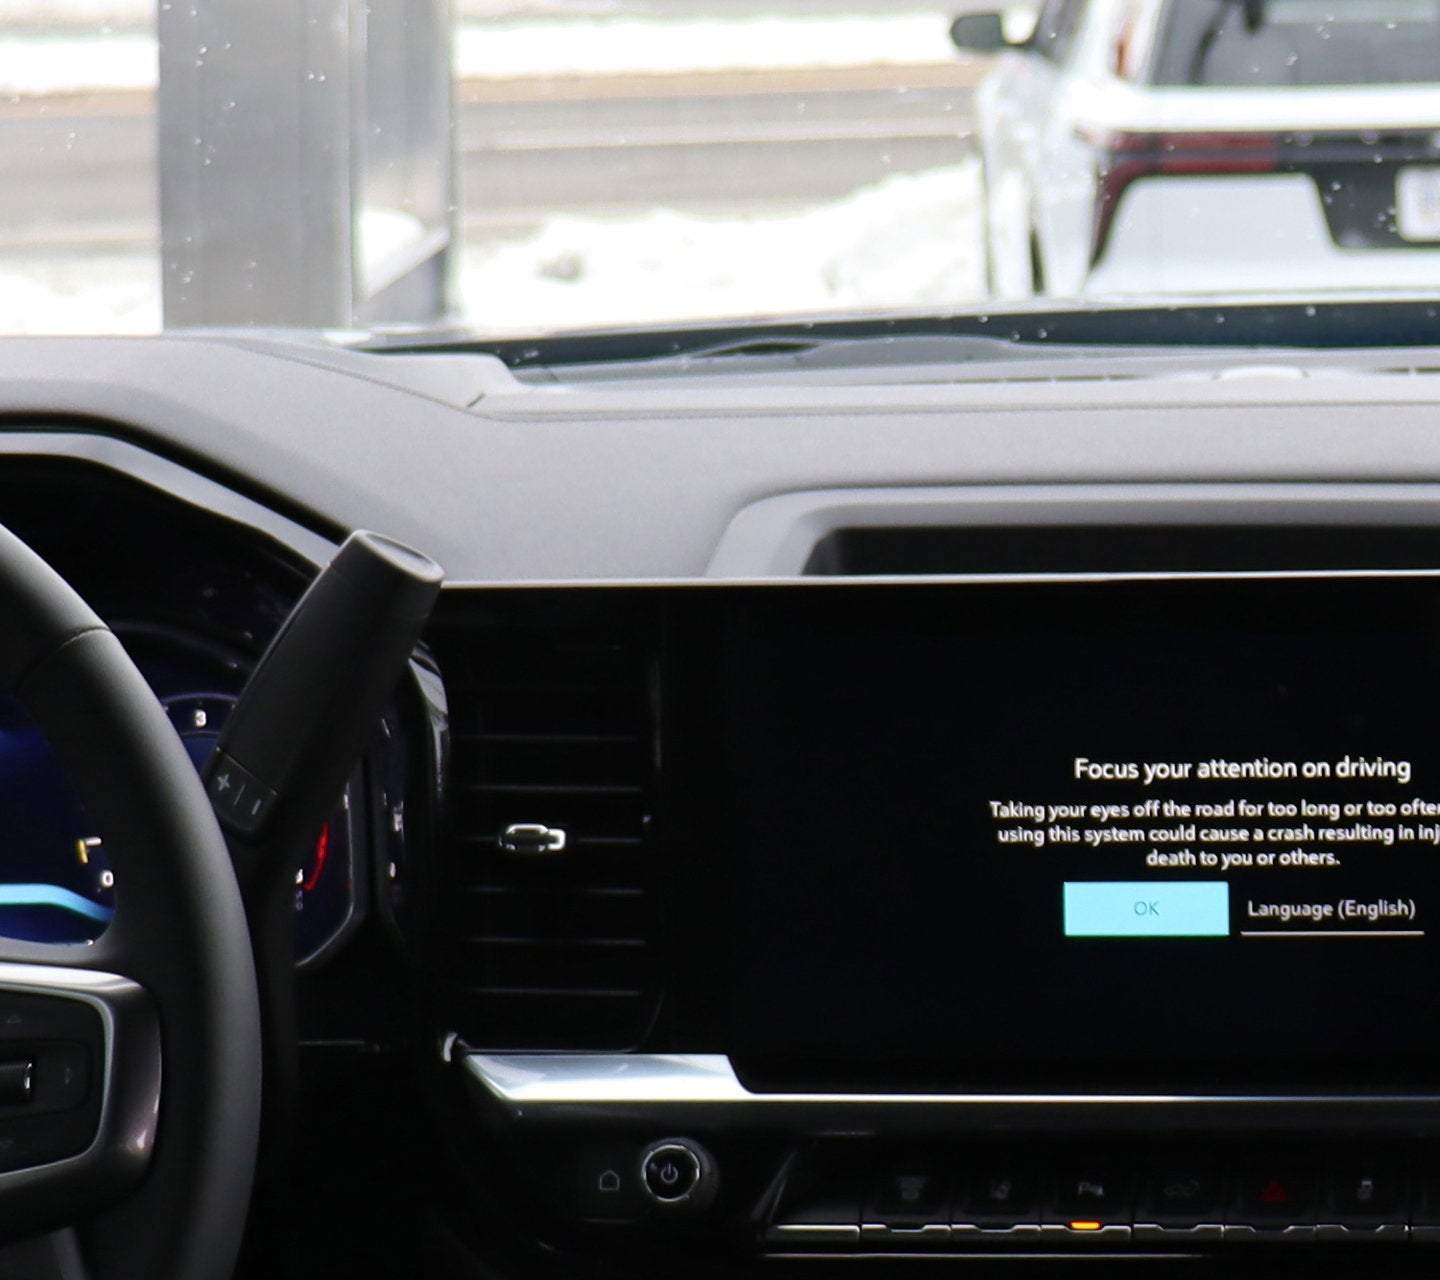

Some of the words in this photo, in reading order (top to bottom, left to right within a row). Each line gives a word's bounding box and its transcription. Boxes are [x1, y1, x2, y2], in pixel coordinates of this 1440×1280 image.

[1074, 757, 1139, 779] Focus
[1143, 762, 1192, 784] your
[1197, 757, 1297, 778] attention
[1301, 761, 1330, 778] on
[1335, 754, 1411, 783] driving
[989, 800, 1045, 821] Taking
[1048, 804, 1086, 821] your
[1089, 804, 1130, 821] eyes
[1132, 799, 1160, 817] off
[1162, 799, 1191, 817] the
[1194, 799, 1234, 816] road
[1237, 798, 1264, 816] for
[1267, 801, 1297, 816] too
[1300, 798, 1340, 820] long
[1343, 803, 1363, 816] or
[1366, 800, 1396, 816] too
[997, 825, 1044, 846] using
[1048, 824, 1080, 842] this
[1084, 826, 1145, 845] system
[1148, 823, 1195, 841] could
[1199, 828, 1249, 841] cause
[1253, 828, 1264, 841] a
[1266, 823, 1314, 841] crash
[1317, 823, 1394, 844] resulting
[1398, 823, 1414, 839] in
[1145, 848, 1196, 866] death
[1199, 850, 1218, 865] to
[1220, 853, 1253, 870] you
[1255, 852, 1275, 865] or
[1278, 847, 1340, 865] others.
[1133, 901, 1160, 916] OK
[1247, 900, 1333, 921] Language
[1337, 898, 1415, 920] (English)
